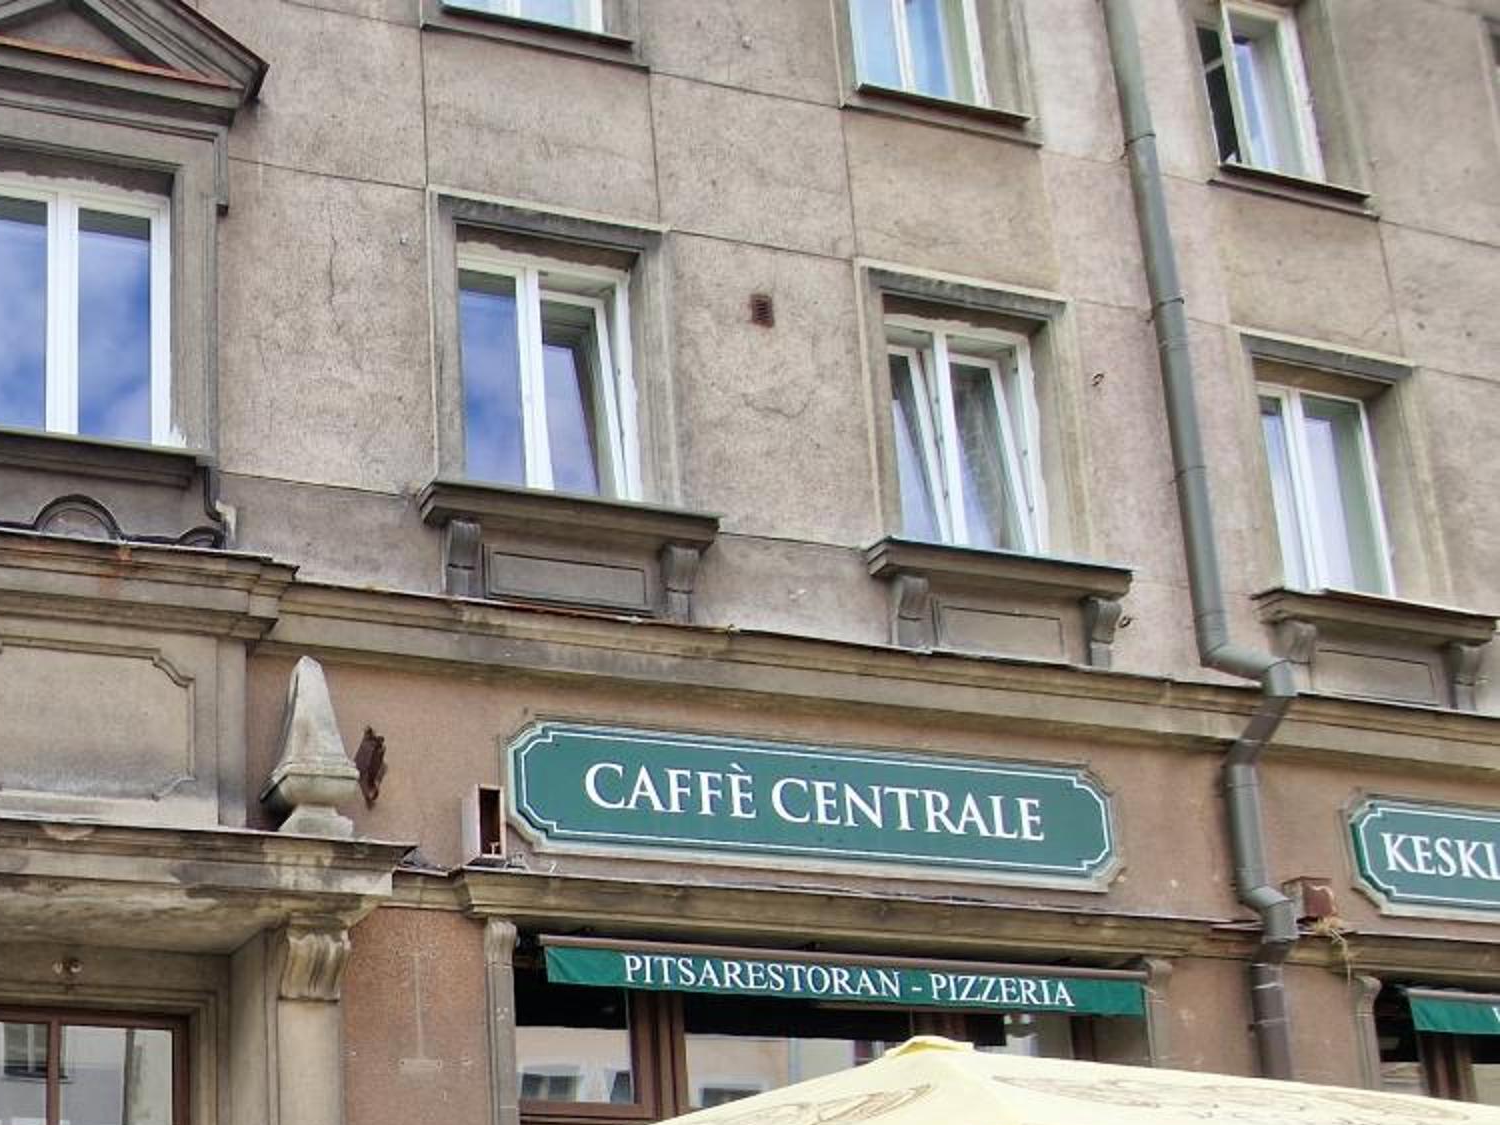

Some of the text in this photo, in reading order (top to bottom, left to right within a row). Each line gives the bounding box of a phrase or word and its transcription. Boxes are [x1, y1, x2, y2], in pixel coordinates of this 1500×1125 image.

[584, 762, 1045, 841] CAFFÈ CENTRALE
[624, 955, 901, 997] PITSARESTORAN
[930, 973, 1075, 1007] PIZZERIA
